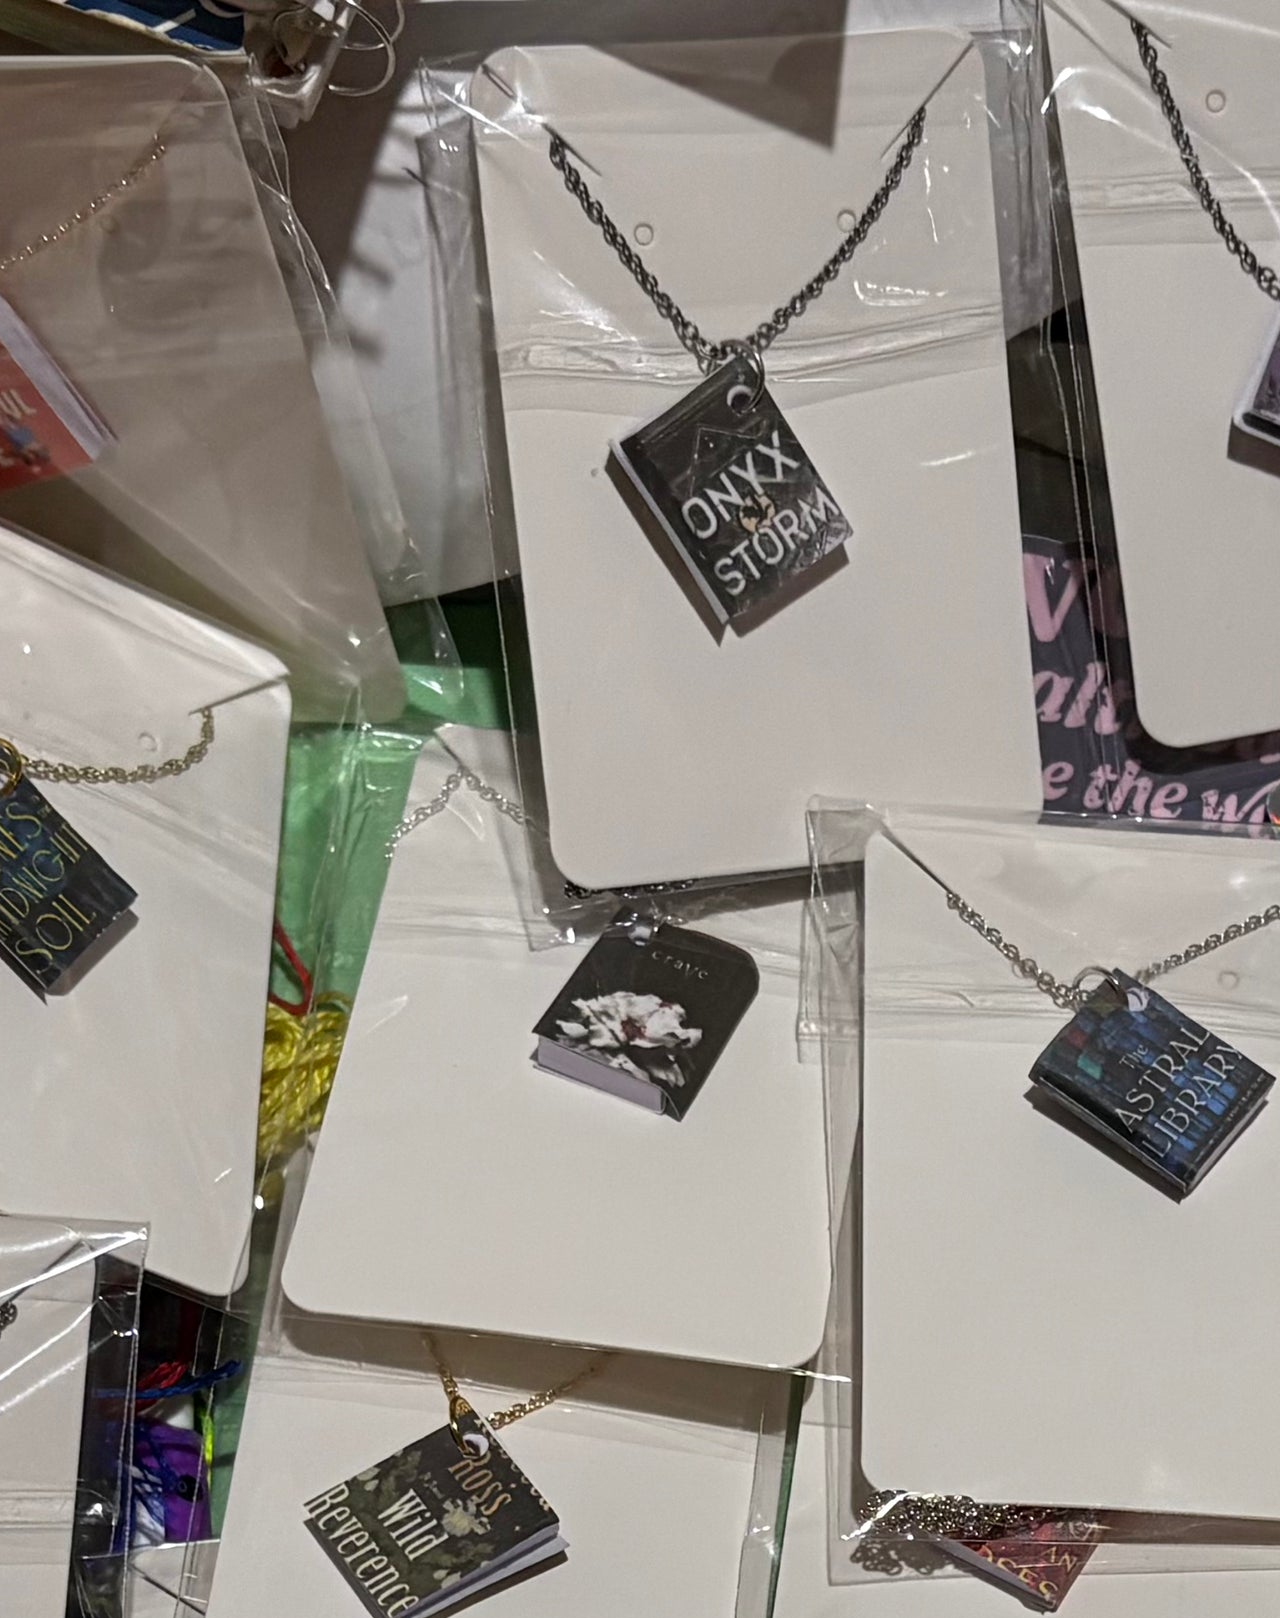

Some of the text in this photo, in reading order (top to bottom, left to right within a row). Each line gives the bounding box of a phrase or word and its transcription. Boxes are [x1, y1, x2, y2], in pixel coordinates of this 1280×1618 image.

[681, 430, 801, 540] ONYX
[714, 487, 841, 596] STORM
[1083, 758, 1188, 819] the
[15, 894, 98, 975] SOIL
[651, 949, 710, 981] crave
[1115, 1026, 1211, 1133] ASTRAL
[1120, 1043, 1149, 1069] The
[1142, 1044, 1244, 1158] LIBRARY
[304, 1483, 420, 1618] Reverence
[377, 1488, 450, 1562] Wild
